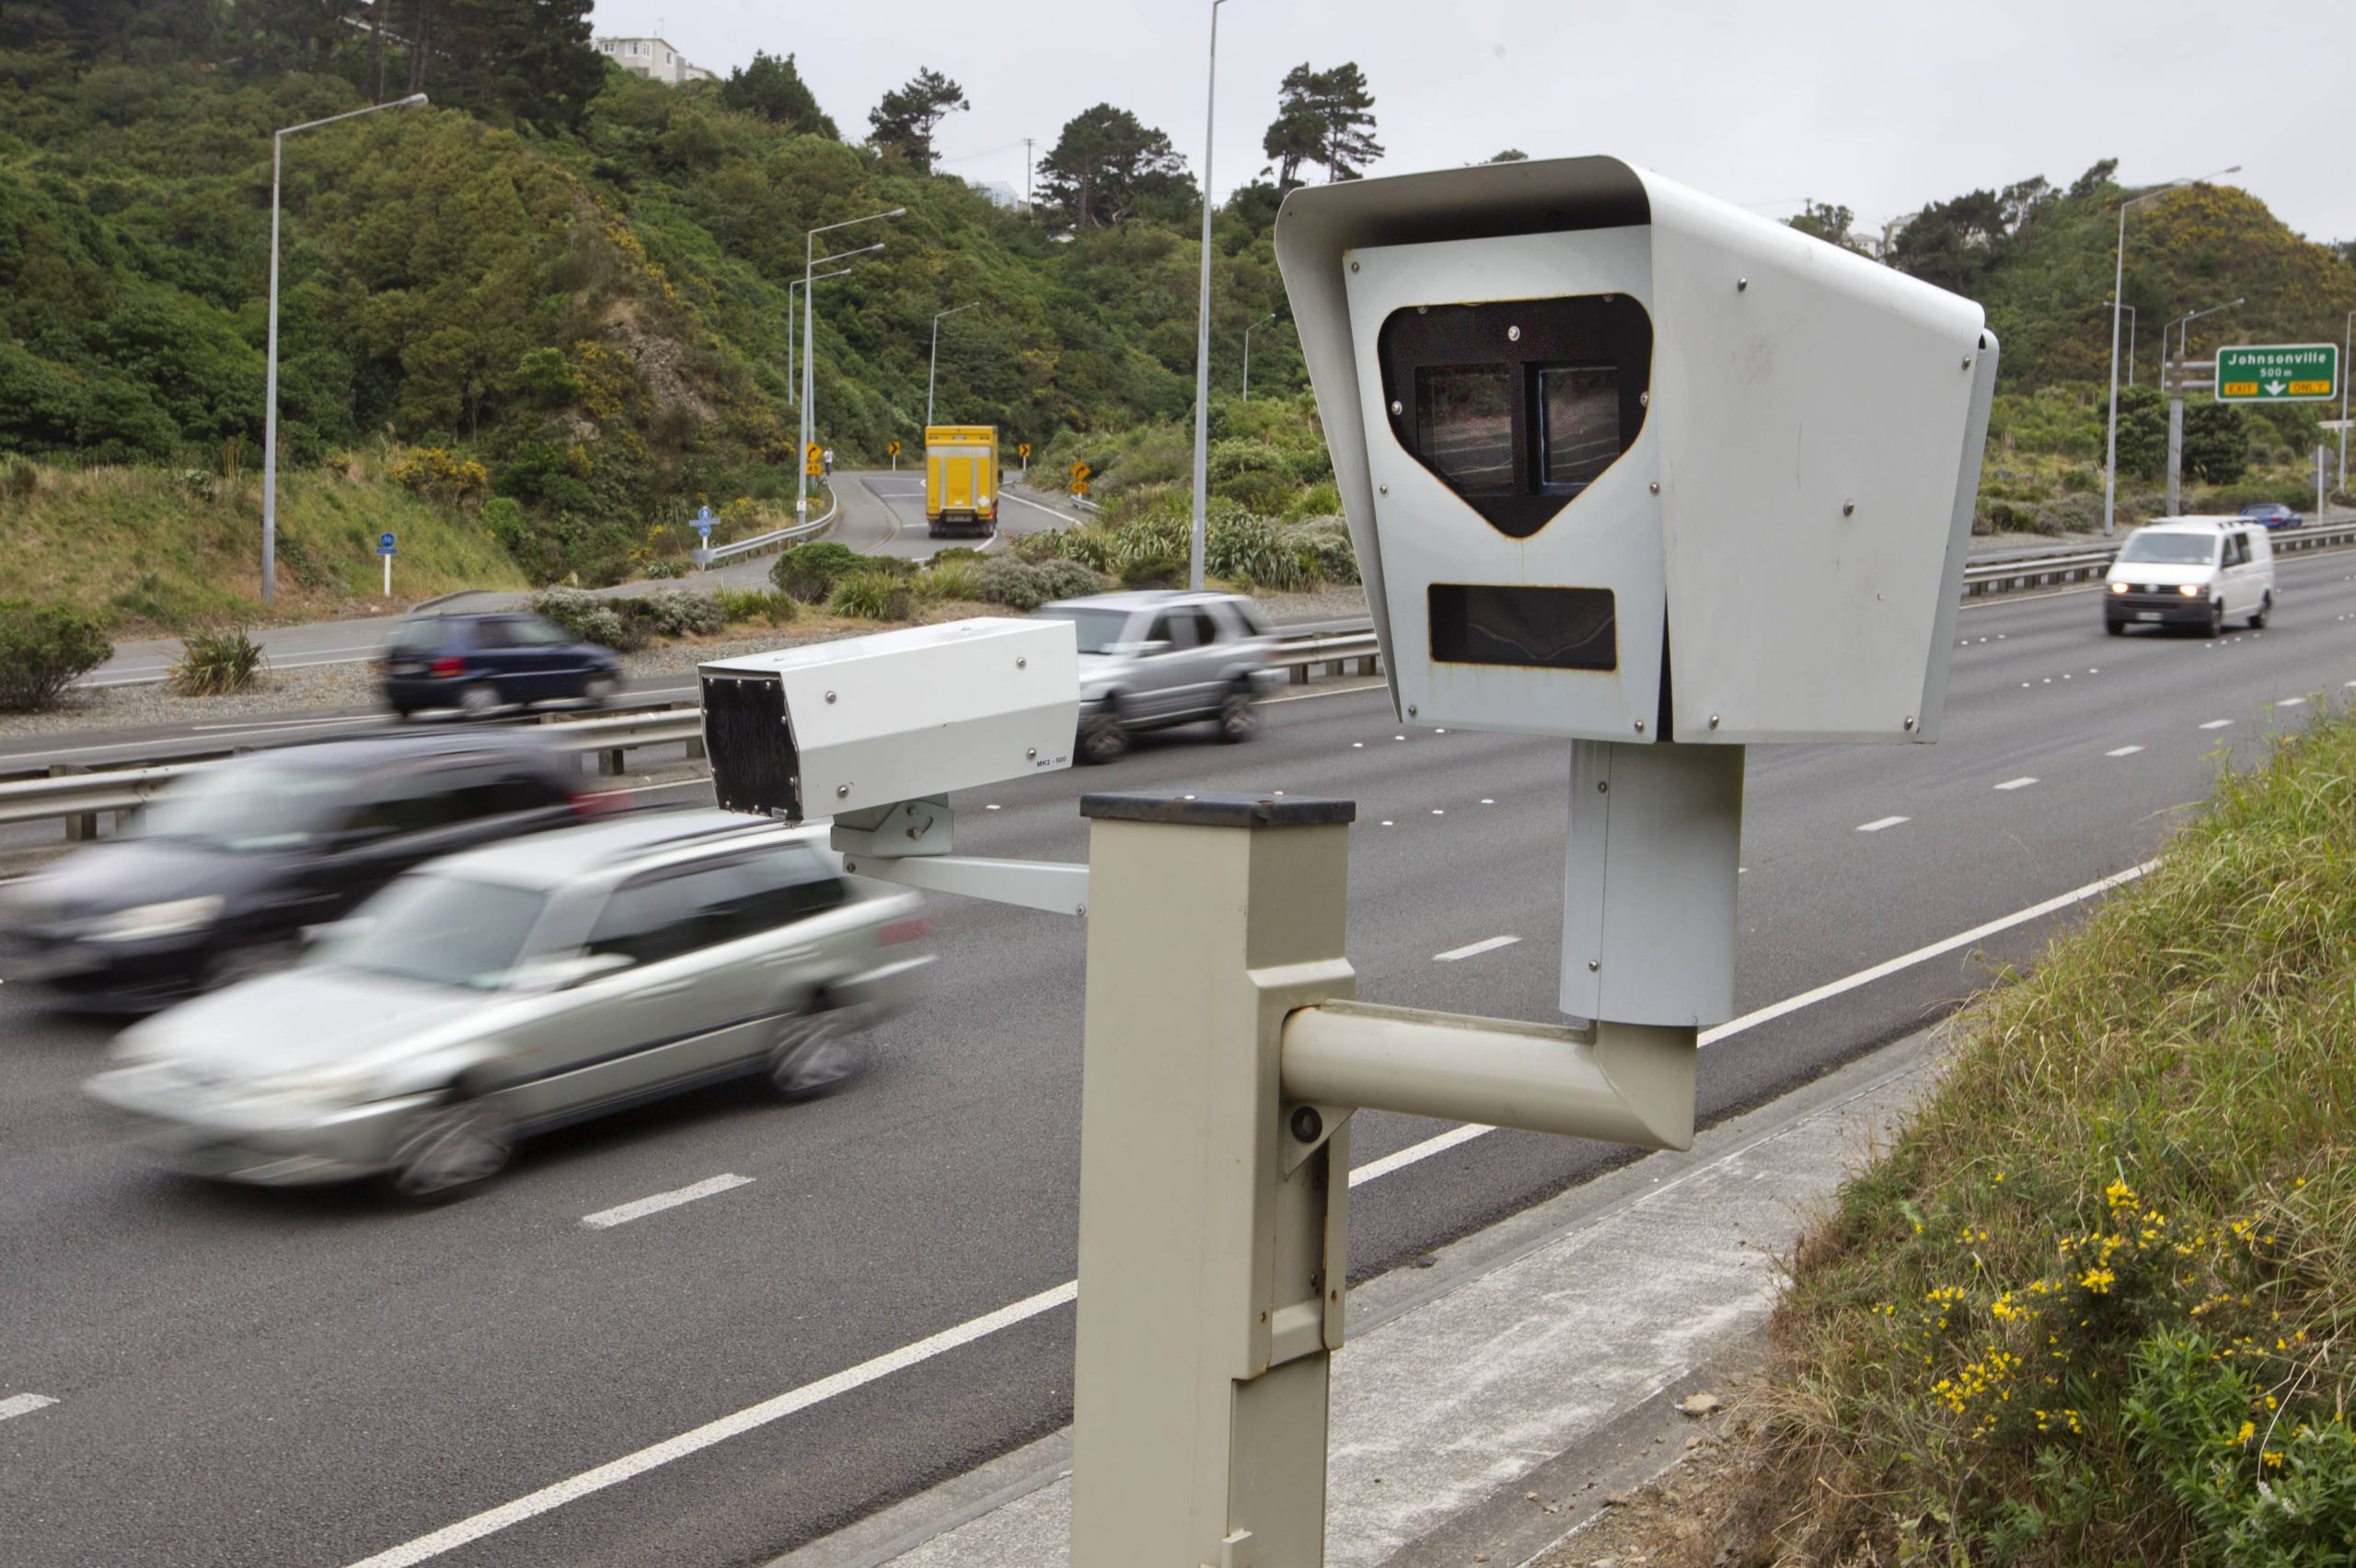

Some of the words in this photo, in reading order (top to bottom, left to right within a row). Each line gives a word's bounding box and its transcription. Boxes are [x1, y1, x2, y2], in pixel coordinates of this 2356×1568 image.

[2228, 352, 2327, 365] Johnsonville
[2228, 384, 2253, 393] EXIT
[2293, 382, 2326, 392] ONLY
